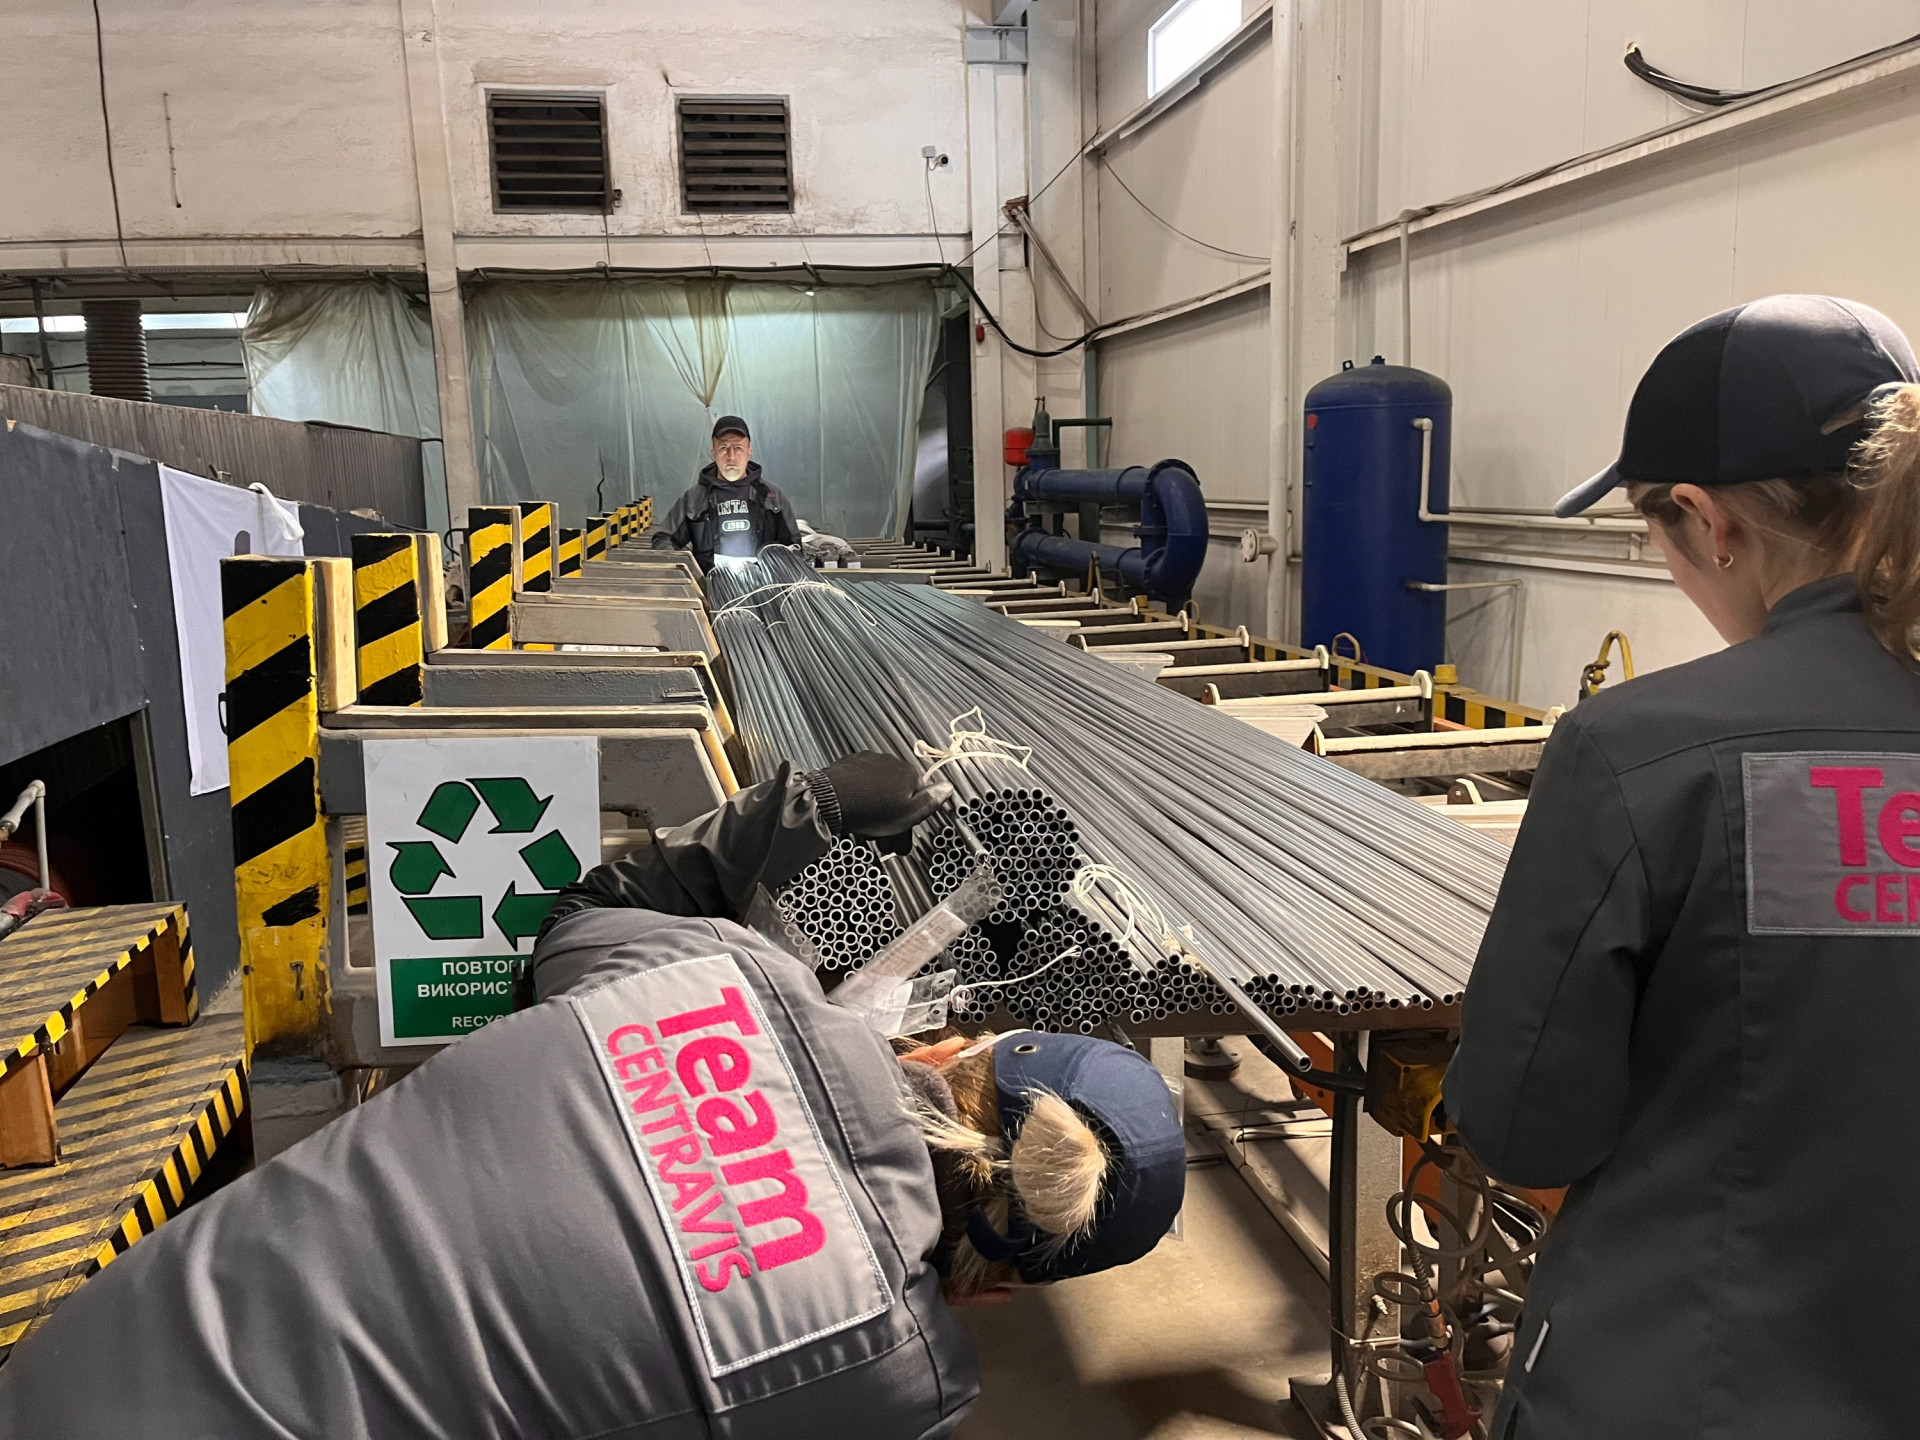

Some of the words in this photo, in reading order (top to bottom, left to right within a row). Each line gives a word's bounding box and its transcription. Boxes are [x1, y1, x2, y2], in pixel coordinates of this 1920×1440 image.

[417, 981, 512, 998] ВИКОРИС
[606, 1023, 752, 1292] CENTRAVIS
[656, 986, 828, 1272] Team
